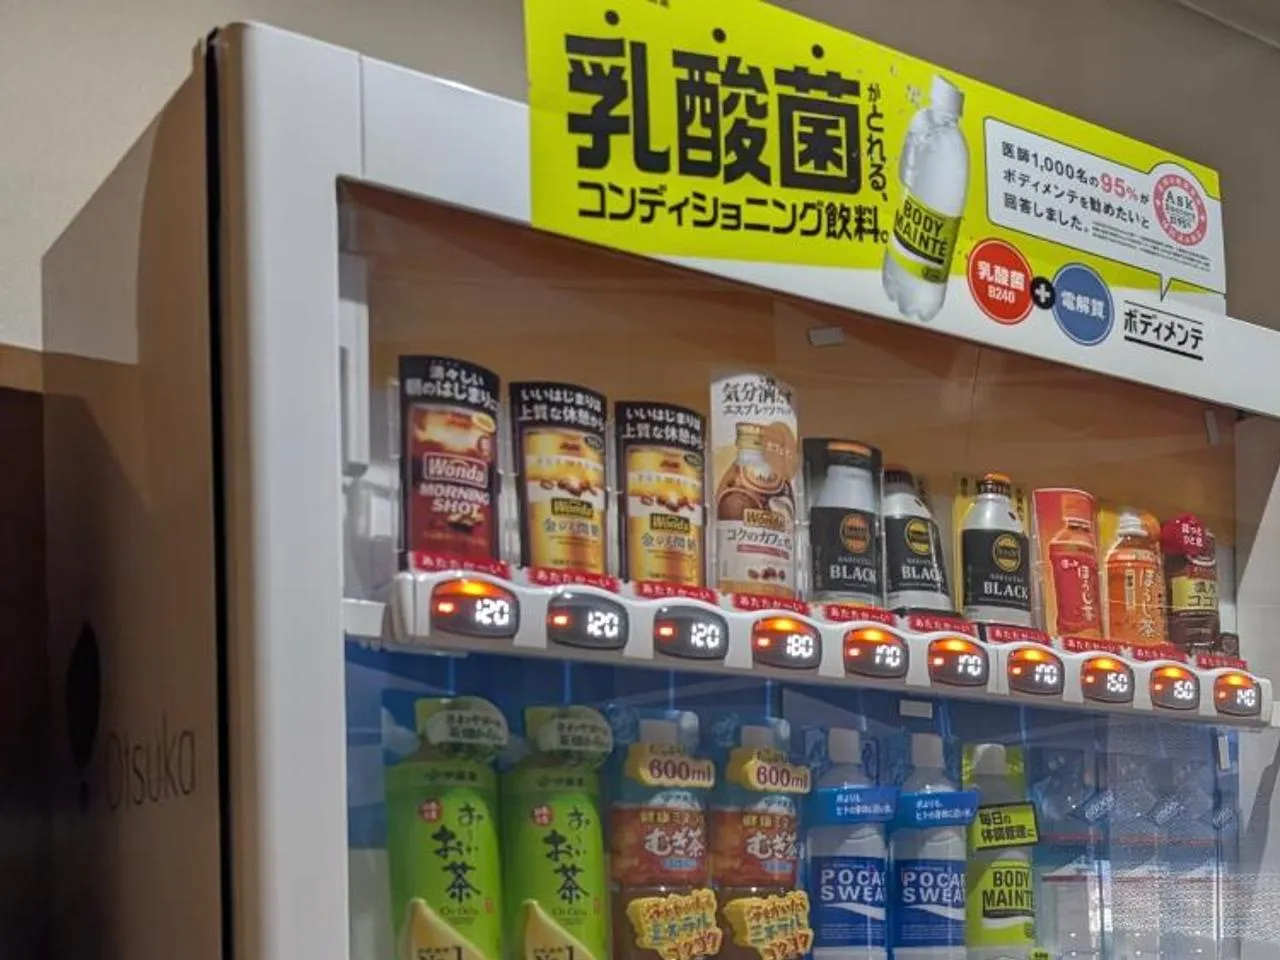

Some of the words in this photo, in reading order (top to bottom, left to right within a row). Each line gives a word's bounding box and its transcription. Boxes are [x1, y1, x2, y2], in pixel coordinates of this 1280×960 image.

[565, 33, 861, 194] 乳酸菌
[578, 181, 889, 244] コンディショニング飲料。
[904, 199, 943, 237] BODY
[1004, 192, 1089, 233] 回答しました。
[977, 261, 1025, 290] 乳酸菌
[1124, 308, 1204, 350] ボディメンテ
[983, 582, 1029, 599] BLACK
[475, 599, 510, 625] 120
[587, 611, 619, 637] 120
[690, 623, 720, 648] 120
[786, 633, 814, 659] 180
[650, 758, 712, 782] 600ml
[756, 766, 809, 789] 600ml
[644, 829, 705, 858] むぎ茶
[432, 825, 481, 903] お茶
[542, 829, 590, 904] お茶
[820, 870, 885, 885] POCA
[902, 872, 965, 886] POCA
[992, 870, 1030, 887] BODY
[820, 885, 886, 902] SWEA
[902, 886, 966, 903] SWEA
